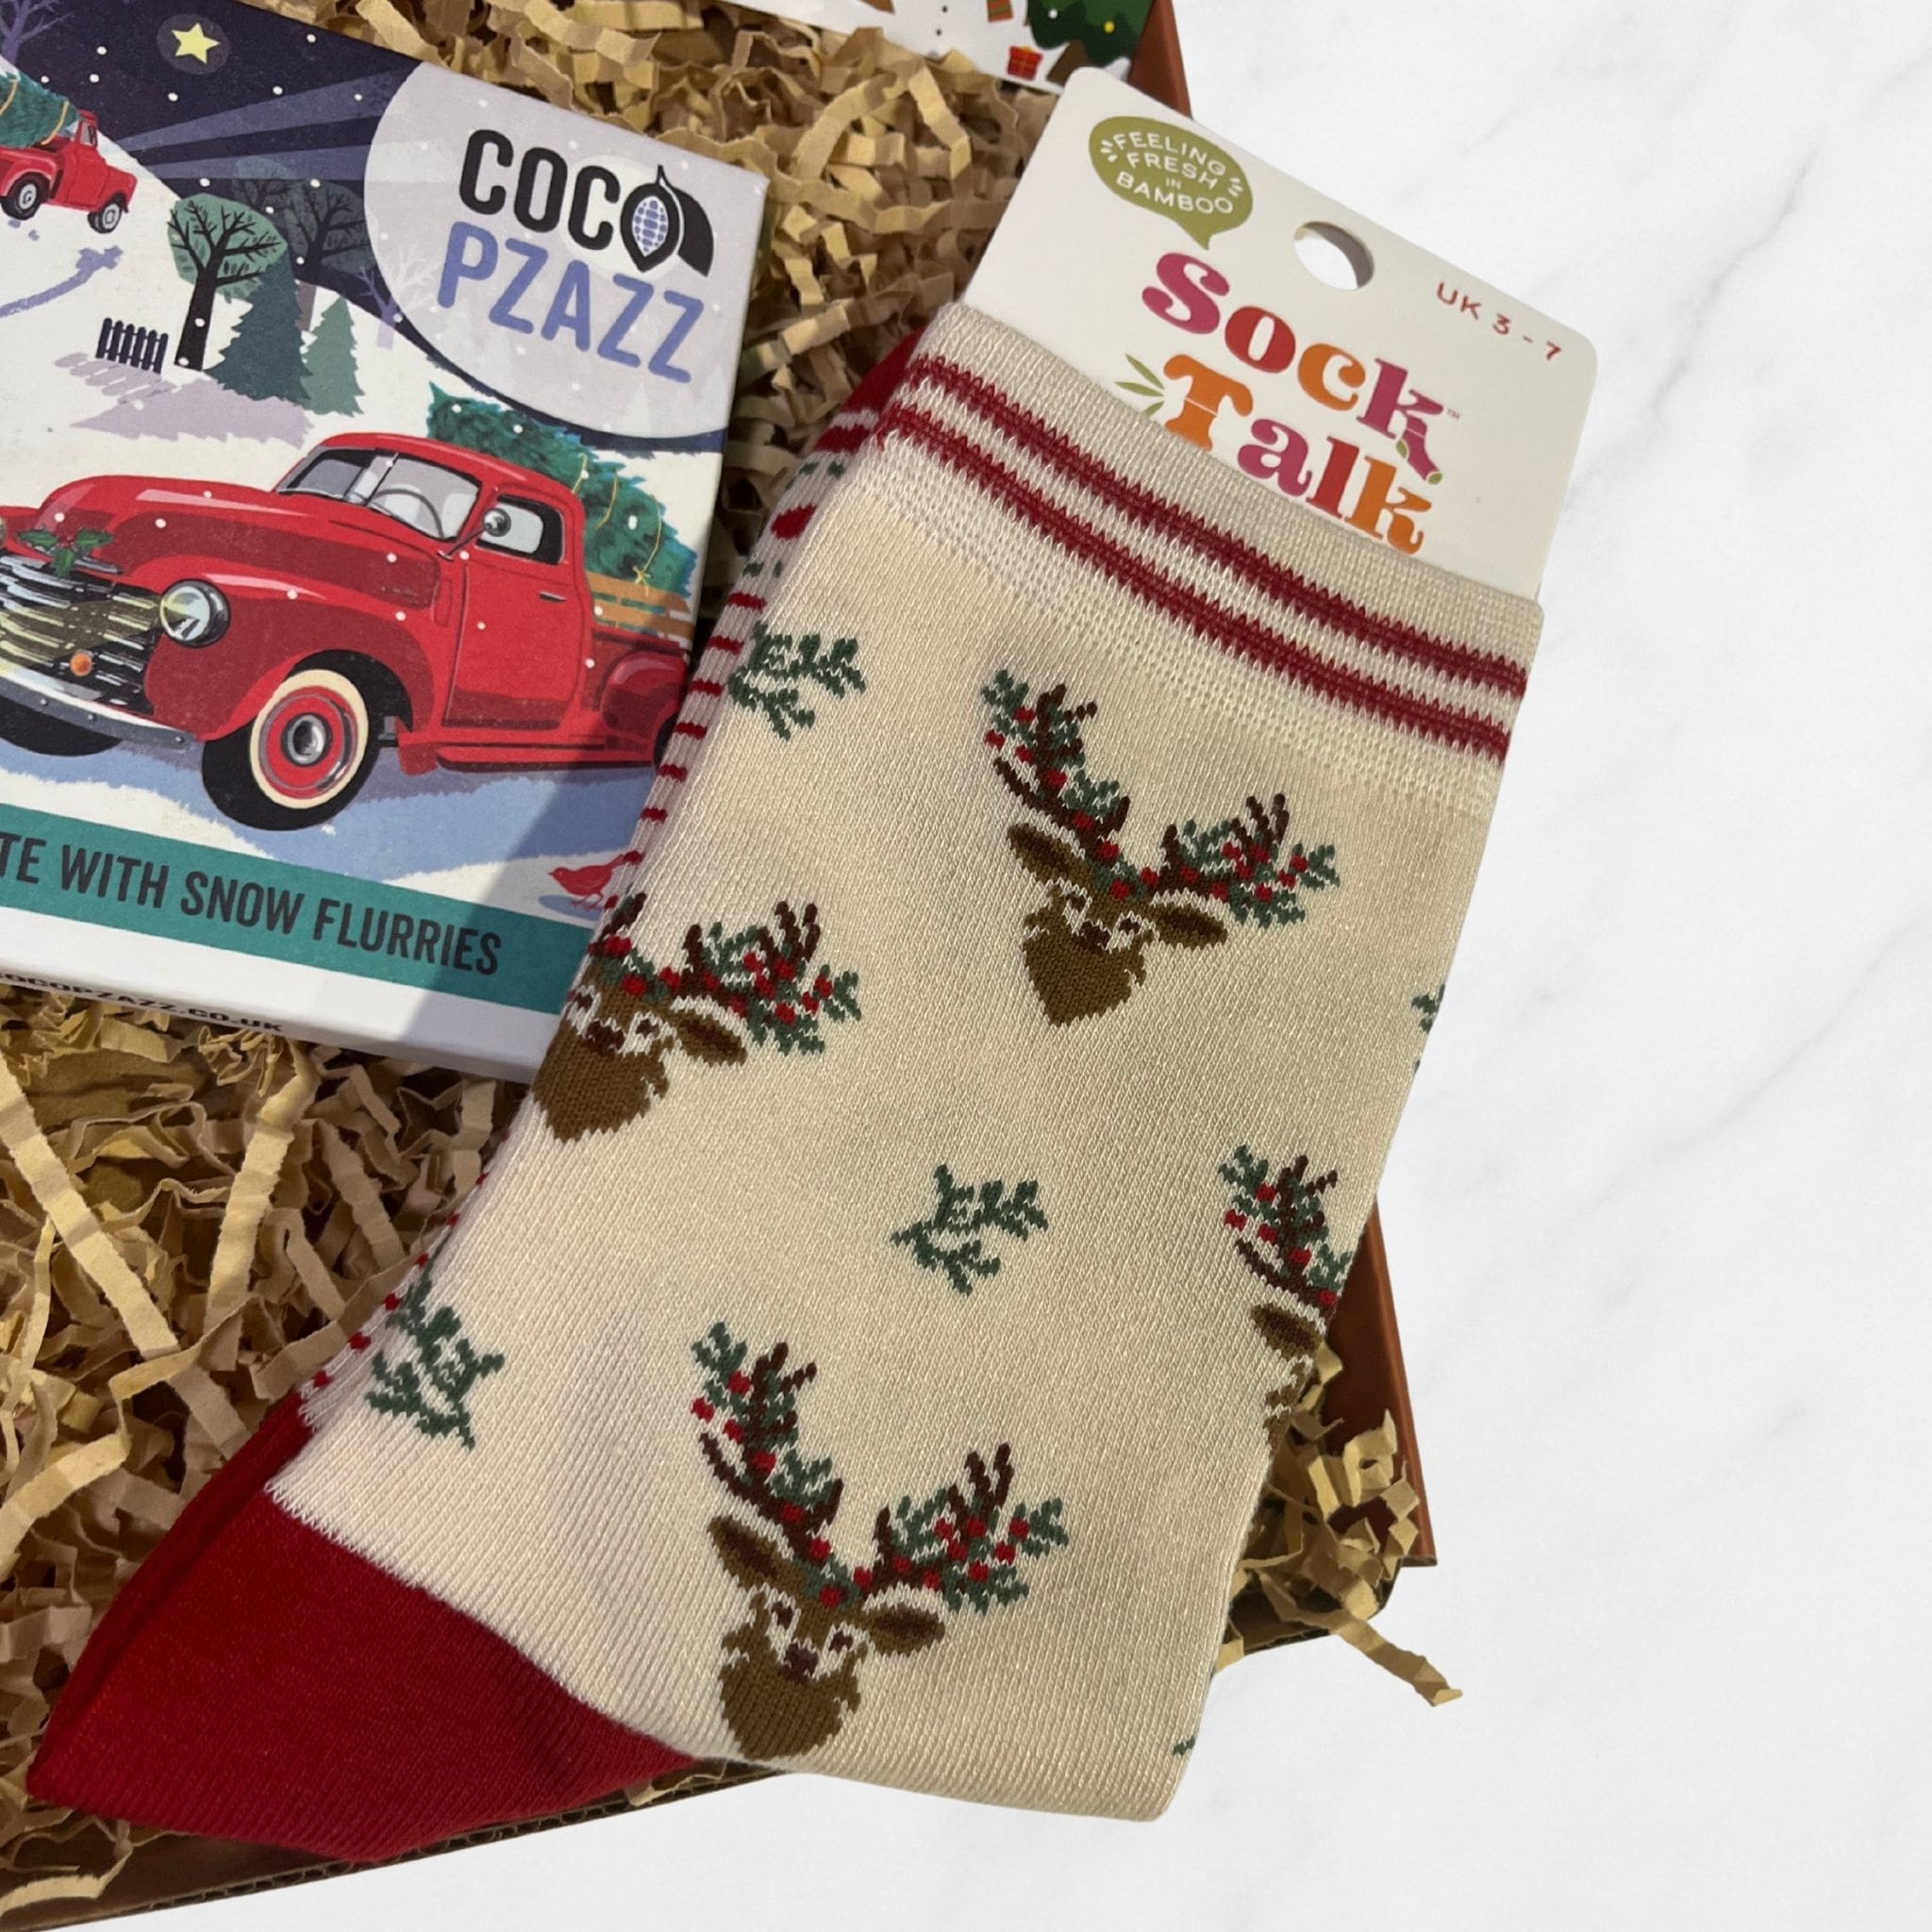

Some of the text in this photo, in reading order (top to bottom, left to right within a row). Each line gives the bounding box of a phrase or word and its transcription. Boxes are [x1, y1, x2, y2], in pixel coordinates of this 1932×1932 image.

[1113, 131, 1226, 176] FEELING
[1126, 152, 1218, 190] FRESH
[1116, 171, 1234, 214] BAMBOO
[1165, 177, 1182, 190] IN
[437, 221, 705, 384] PZAZZ
[1436, 281, 1482, 321] UK
[1141, 252, 1444, 485] Sock
[1163, 353, 1433, 556] Talk
[61, 843, 170, 908] WITH
[180, 871, 305, 936] SNOW
[313, 898, 502, 977] FLURRIES
